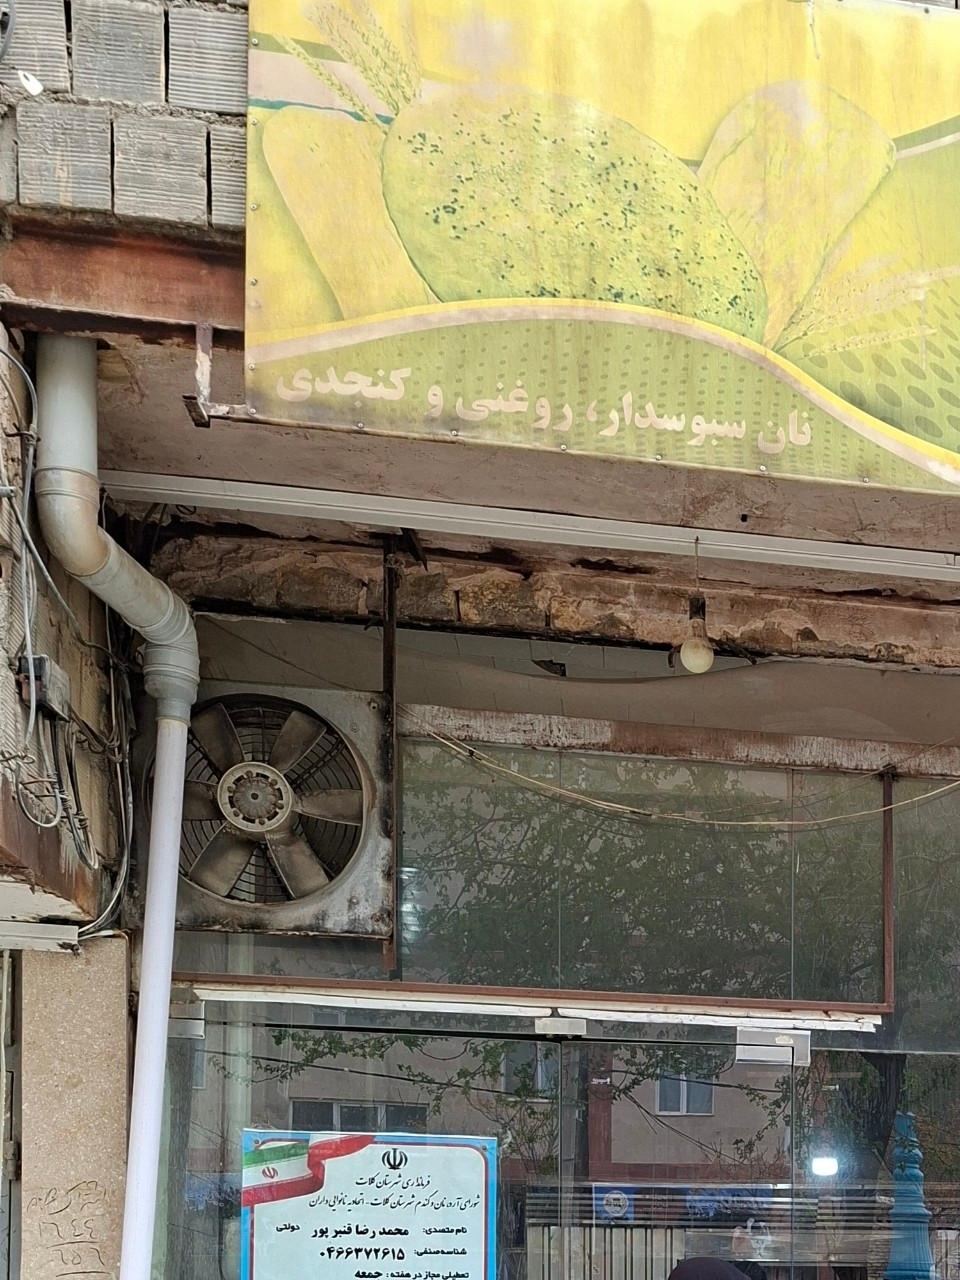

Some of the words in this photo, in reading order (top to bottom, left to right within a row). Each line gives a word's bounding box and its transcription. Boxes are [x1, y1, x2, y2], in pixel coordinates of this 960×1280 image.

[276, 367, 413, 408] کنجدی
[424, 384, 444, 418] و
[455, 380, 574, 430] روغنی
[757, 409, 812, 454] نان
[276, 1222, 301, 1233] دولتی
[311, 1226, 329, 1239] پور
[331, 1223, 352, 1239] قنبر
[355, 1223, 377, 1239] رضا
[379, 1225, 410, 1237] محمد
[456, 1226, 468, 1235] نام
